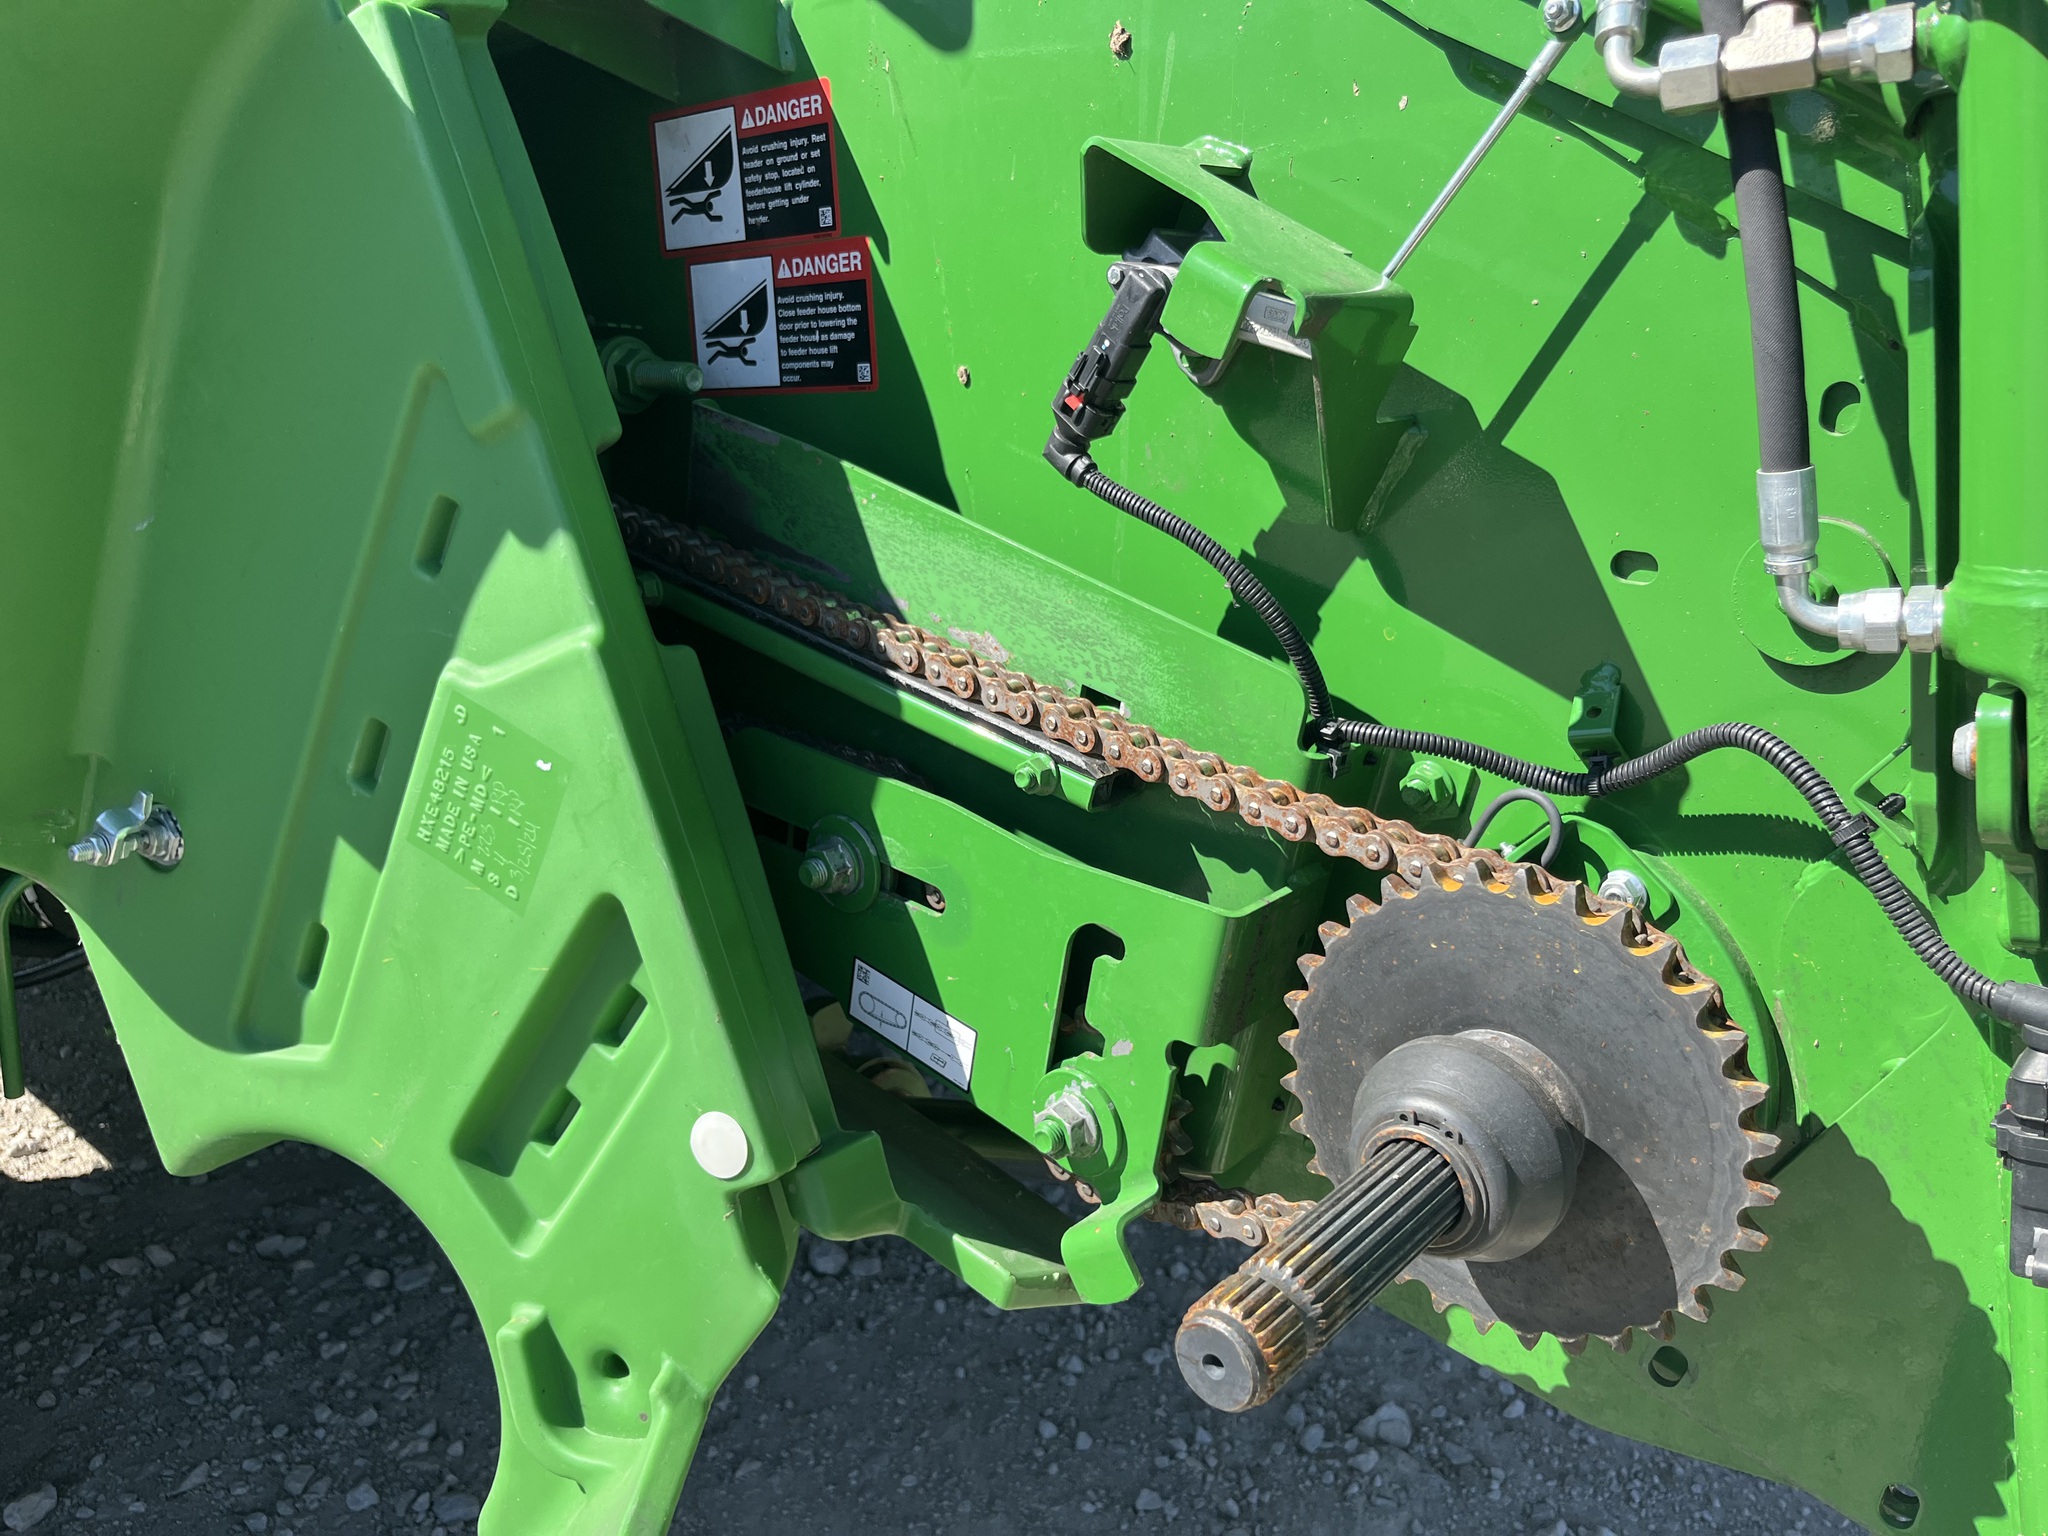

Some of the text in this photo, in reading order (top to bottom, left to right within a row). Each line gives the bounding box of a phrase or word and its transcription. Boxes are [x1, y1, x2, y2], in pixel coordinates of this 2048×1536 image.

[755, 95, 822, 126] DANGER
[742, 133, 826, 155] Avoid crushing injury. Rest
[743, 160, 763, 169] header
[777, 153, 798, 166] ground
[811, 149, 820, 158] set
[744, 174, 762, 183] safety
[765, 172, 780, 180] stop,
[782, 166, 804, 177] located
[746, 185, 781, 197] feederhouse
[784, 183, 792, 191] lift
[747, 195, 809, 211] before getting under
[792, 252, 862, 277] DANGER
[778, 292, 844, 304] Avoid crushing injury.
[778, 304, 861, 317] Close feeder house bottom
[779, 318, 857, 331] door prior to lowering the
[780, 335, 799, 343] feeder
[830, 332, 855, 341] damage
[788, 347, 807, 356] feeder
[809, 346, 828, 355] house
[829, 346, 838, 354] lift
[782, 360, 834, 370] components may
[417, 747, 455, 842] HXE48215
[436, 734, 482, 852] MADE IN USA
[471, 858, 485, 876] M
[488, 872, 500, 887] S
[505, 885, 519, 900] D
